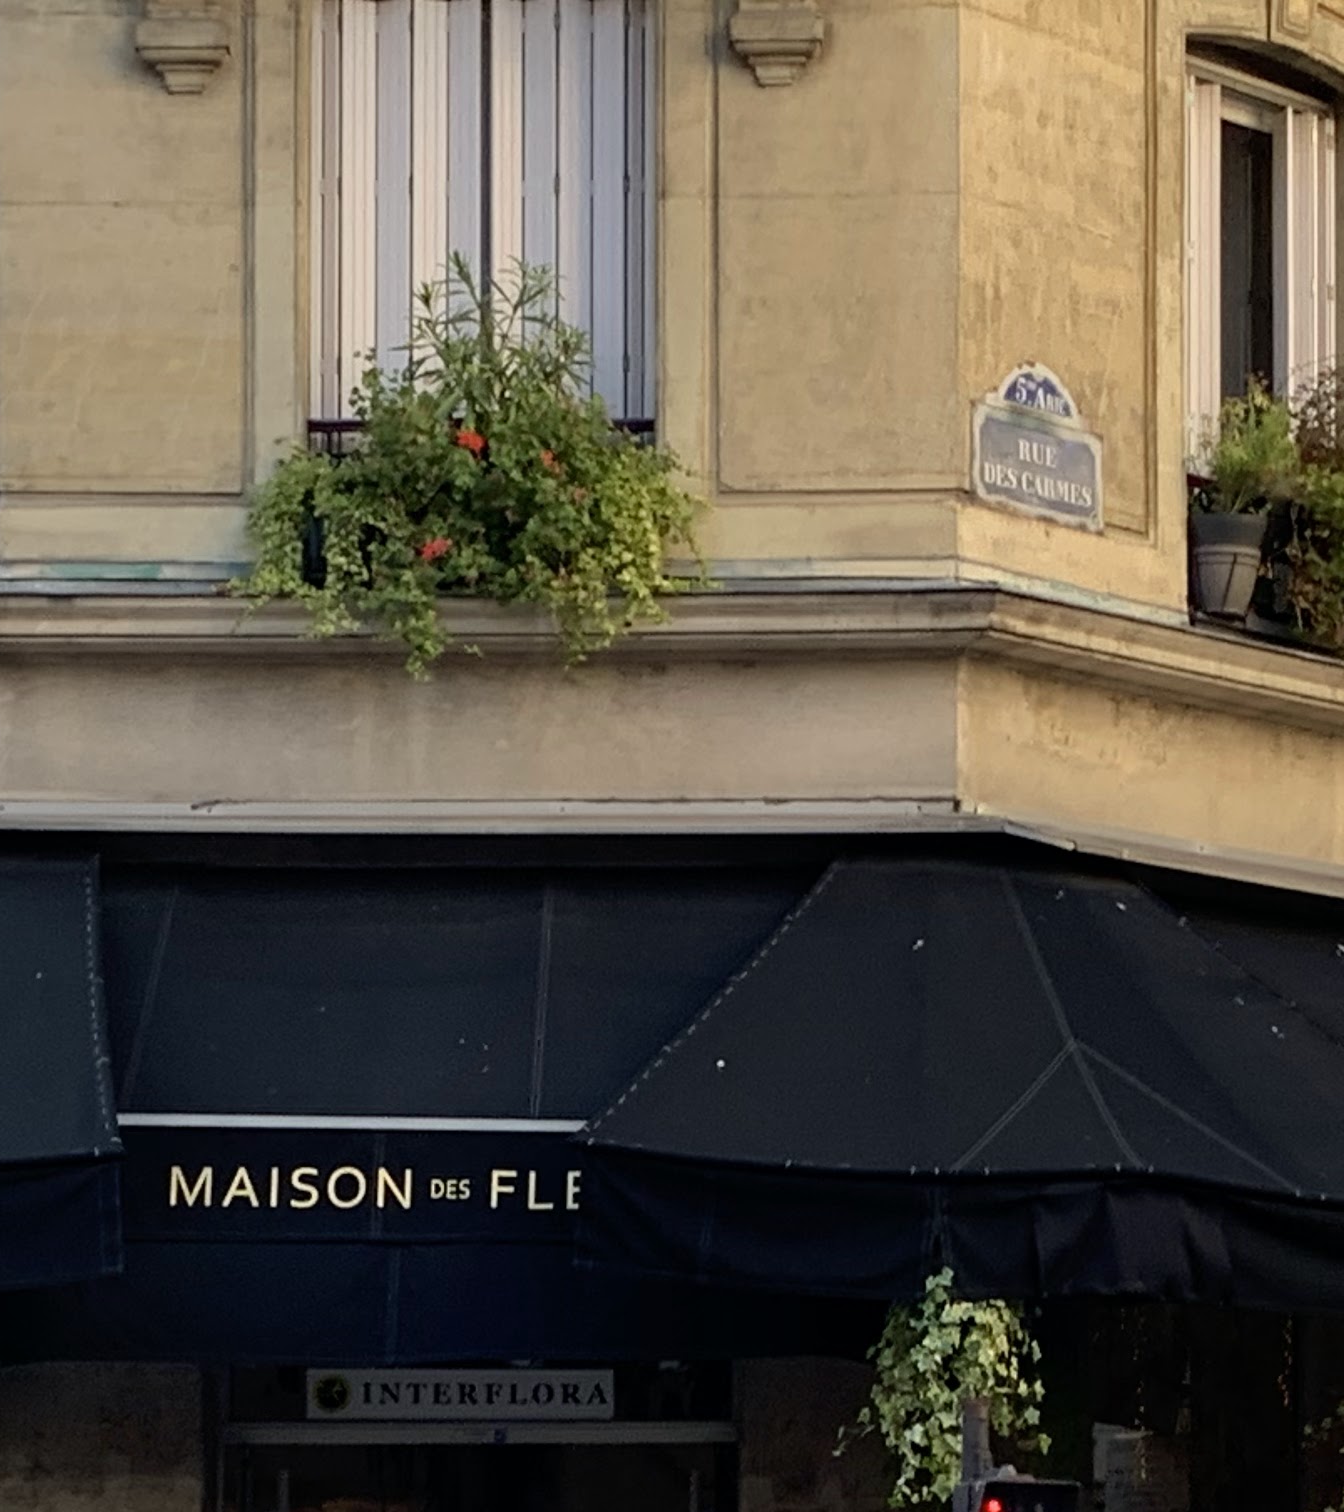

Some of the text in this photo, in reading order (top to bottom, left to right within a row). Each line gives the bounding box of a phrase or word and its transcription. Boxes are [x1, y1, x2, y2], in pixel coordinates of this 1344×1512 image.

[1017, 438, 1057, 469] RUE
[982, 461, 1093, 508] DES CARMES
[168, 1165, 582, 1211] MAISON DES FLE
[362, 1380, 609, 1406] INTERFLORA
